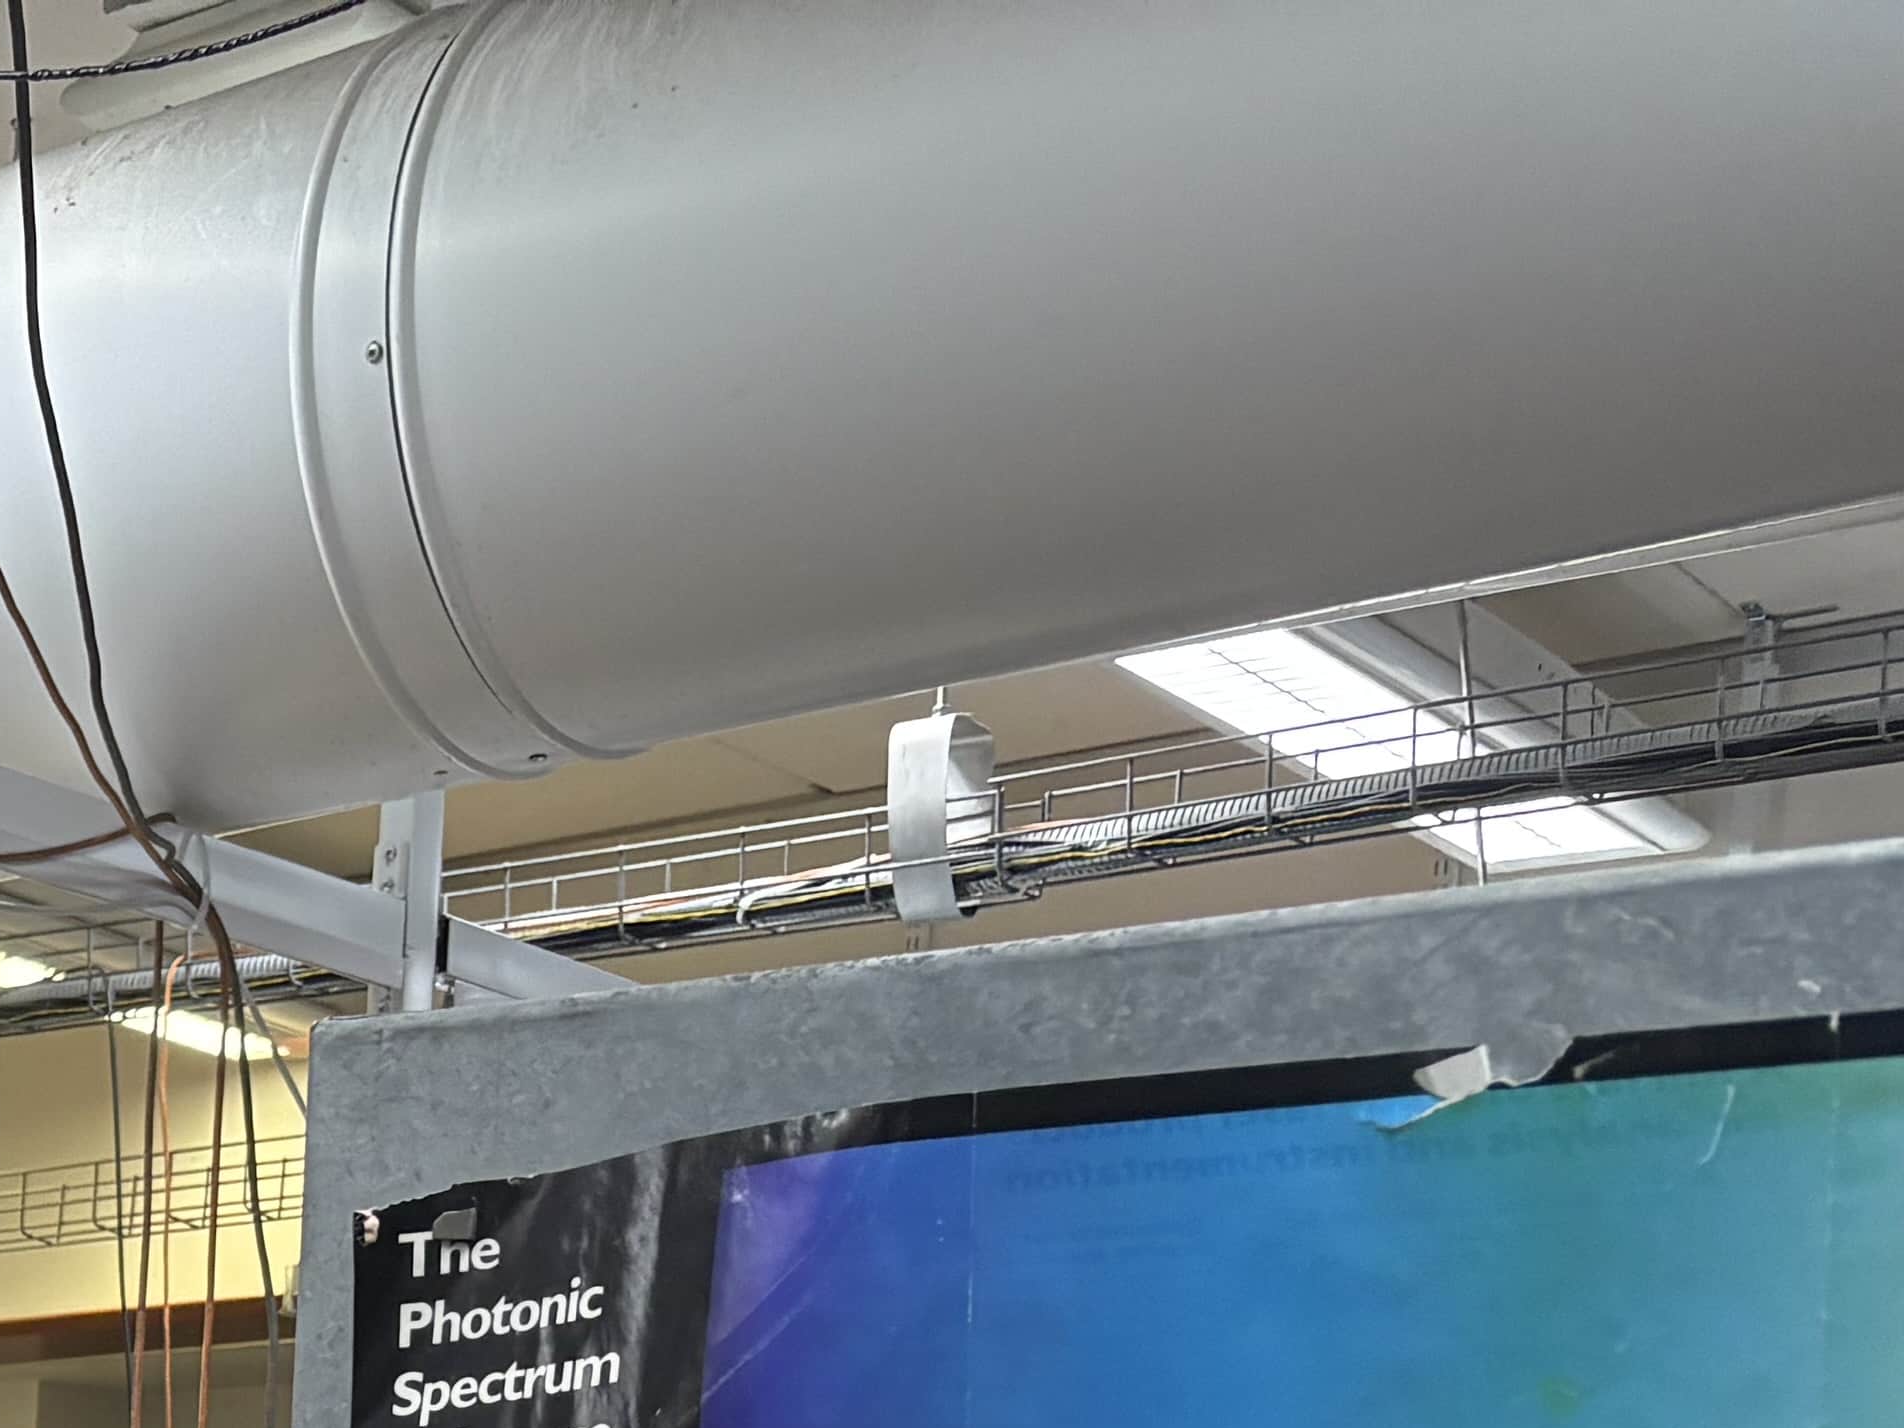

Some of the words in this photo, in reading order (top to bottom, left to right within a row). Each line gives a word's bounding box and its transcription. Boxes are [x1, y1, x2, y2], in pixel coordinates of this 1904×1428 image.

[398, 1228, 500, 1278] The
[398, 1277, 605, 1349] Photonic
[392, 1352, 620, 1427] Spectrum
